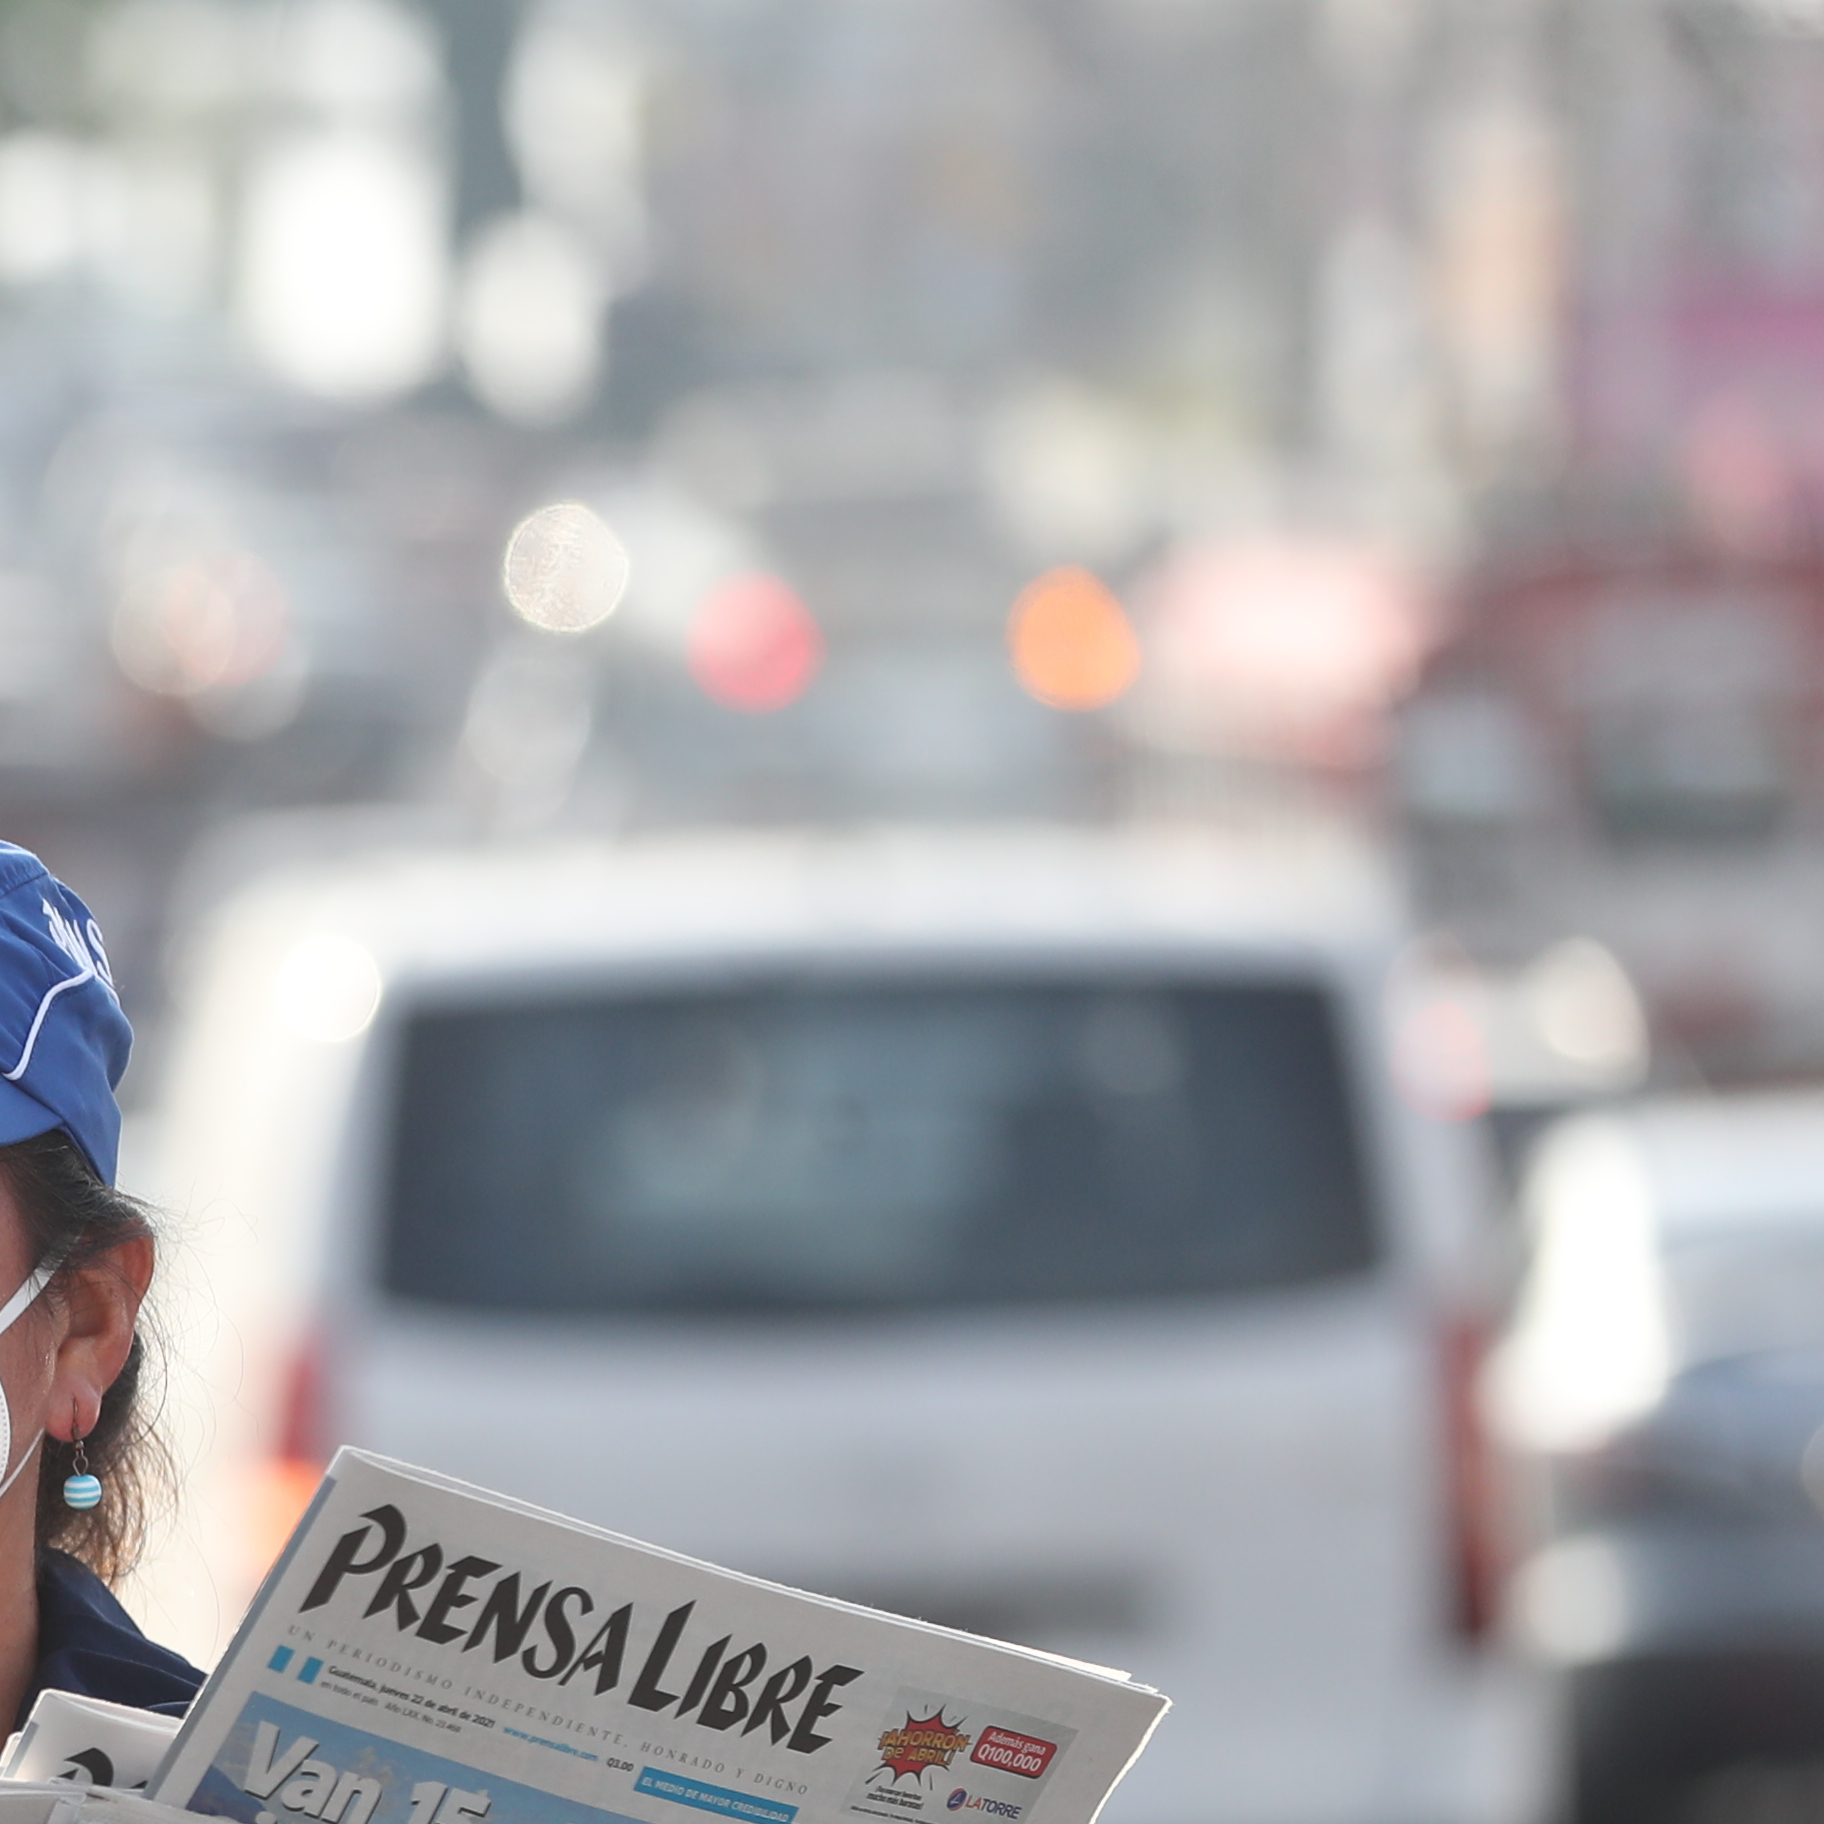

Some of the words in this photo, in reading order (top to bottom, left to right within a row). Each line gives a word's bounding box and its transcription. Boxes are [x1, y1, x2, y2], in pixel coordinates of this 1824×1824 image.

[300, 1505, 635, 1697] PRENSA
[630, 1602, 863, 1752] LIBRE
[977, 1743, 1042, 1772] Q100,000
